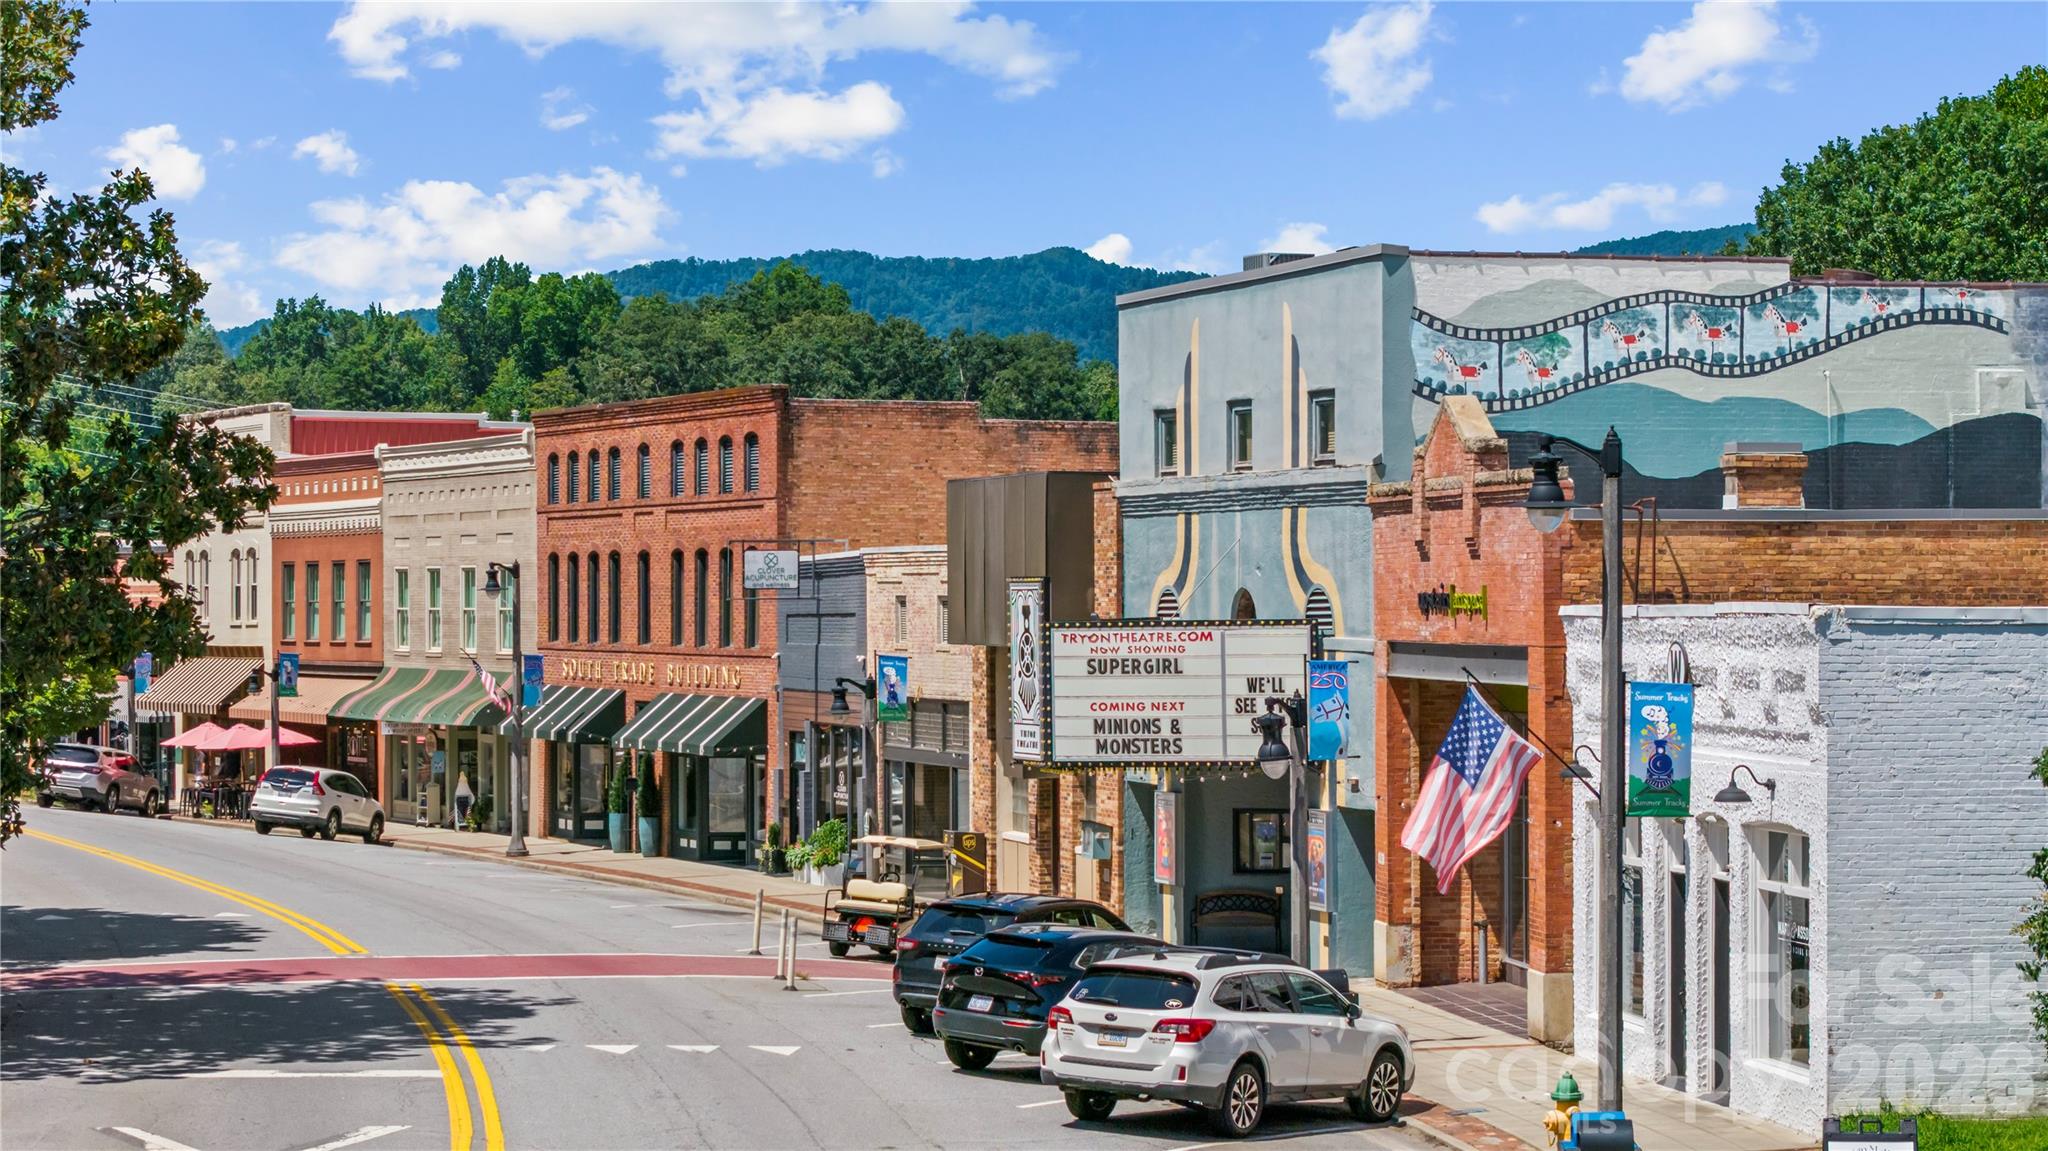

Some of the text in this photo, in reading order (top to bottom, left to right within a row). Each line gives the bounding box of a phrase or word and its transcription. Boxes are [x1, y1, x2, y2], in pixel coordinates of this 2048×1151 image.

[1061, 631, 1213, 645] TRYONTHEATRE.COM
[1090, 645, 1186, 654] NOW SHOWING
[562, 658, 742, 688] SOUTH TRADE BUILDING
[1087, 657, 1183, 675] SUPERGIRL
[1246, 677, 1285, 693] WE'LL
[1634, 691, 1664, 701] Summer
[1090, 702, 1185, 711] COMING NEXT
[1235, 697, 1257, 714] SEE
[1093, 718, 1182, 734] MINIONS &
[1095, 738, 1183, 754] MONSTERS
[1632, 797, 1661, 807] Summer
